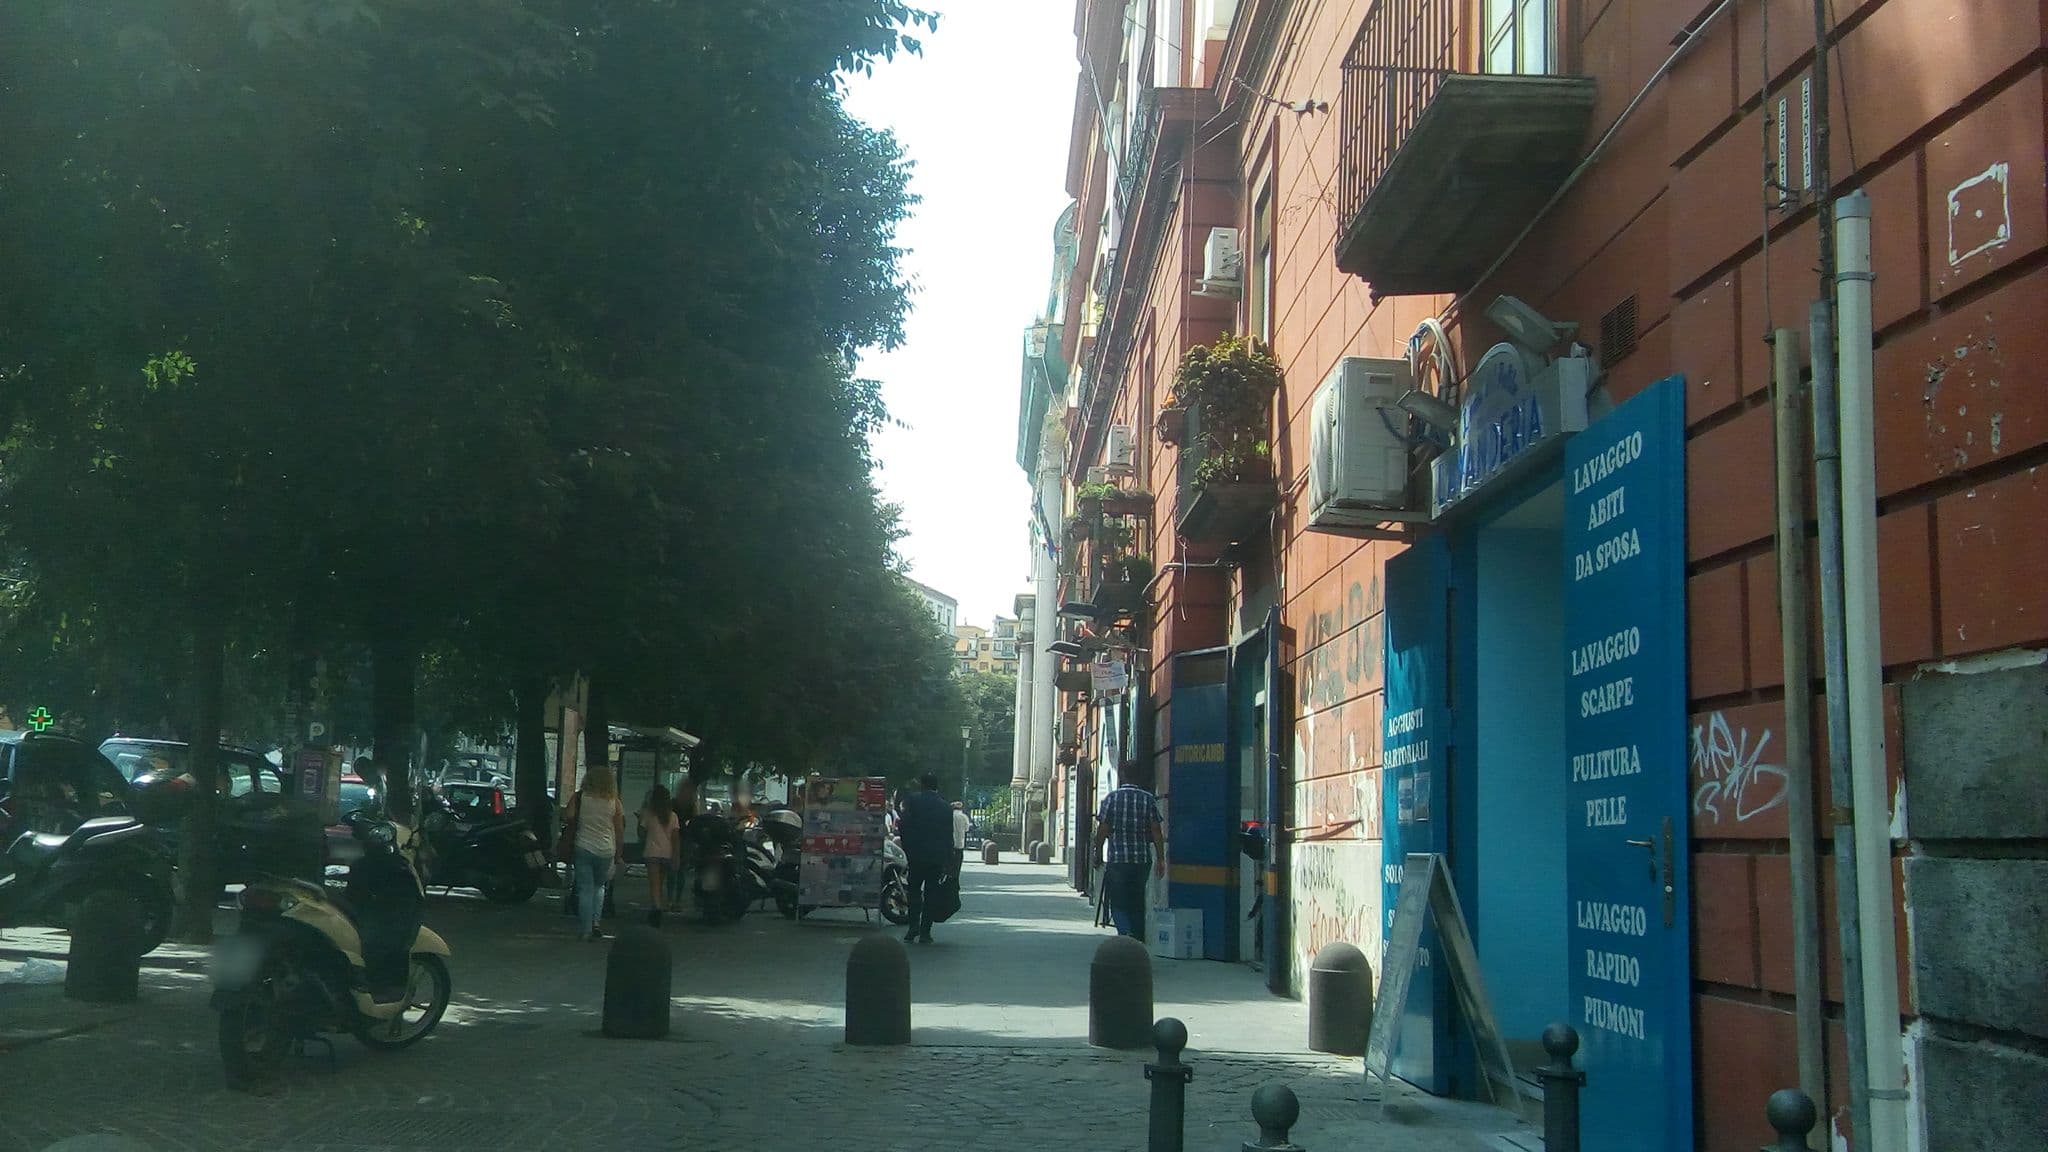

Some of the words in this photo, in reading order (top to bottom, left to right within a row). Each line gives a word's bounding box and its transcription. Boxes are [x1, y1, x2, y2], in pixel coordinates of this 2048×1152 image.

[1574, 430, 1643, 495] LAVAGGIO
[1588, 486, 1625, 531] ABITI
[1574, 554, 1591, 582] DA
[1595, 527, 1641, 573] SPOSA
[1571, 626, 1641, 677] LAVAGGIO
[1580, 677, 1634, 719] SCARPE
[309, 720, 325, 742] P
[1387, 708, 1424, 738] AGGIUSTI
[1383, 740, 1429, 770] SARTORIALI
[1572, 744, 1642, 783] PULITURA
[1586, 796, 1628, 828] PELLE
[1384, 864, 1404, 884] SOLO
[1576, 900, 1647, 938] LAVAGGIO
[1586, 949, 1640, 987] RAPIDO
[1583, 995, 1645, 1040] PIUMONI
